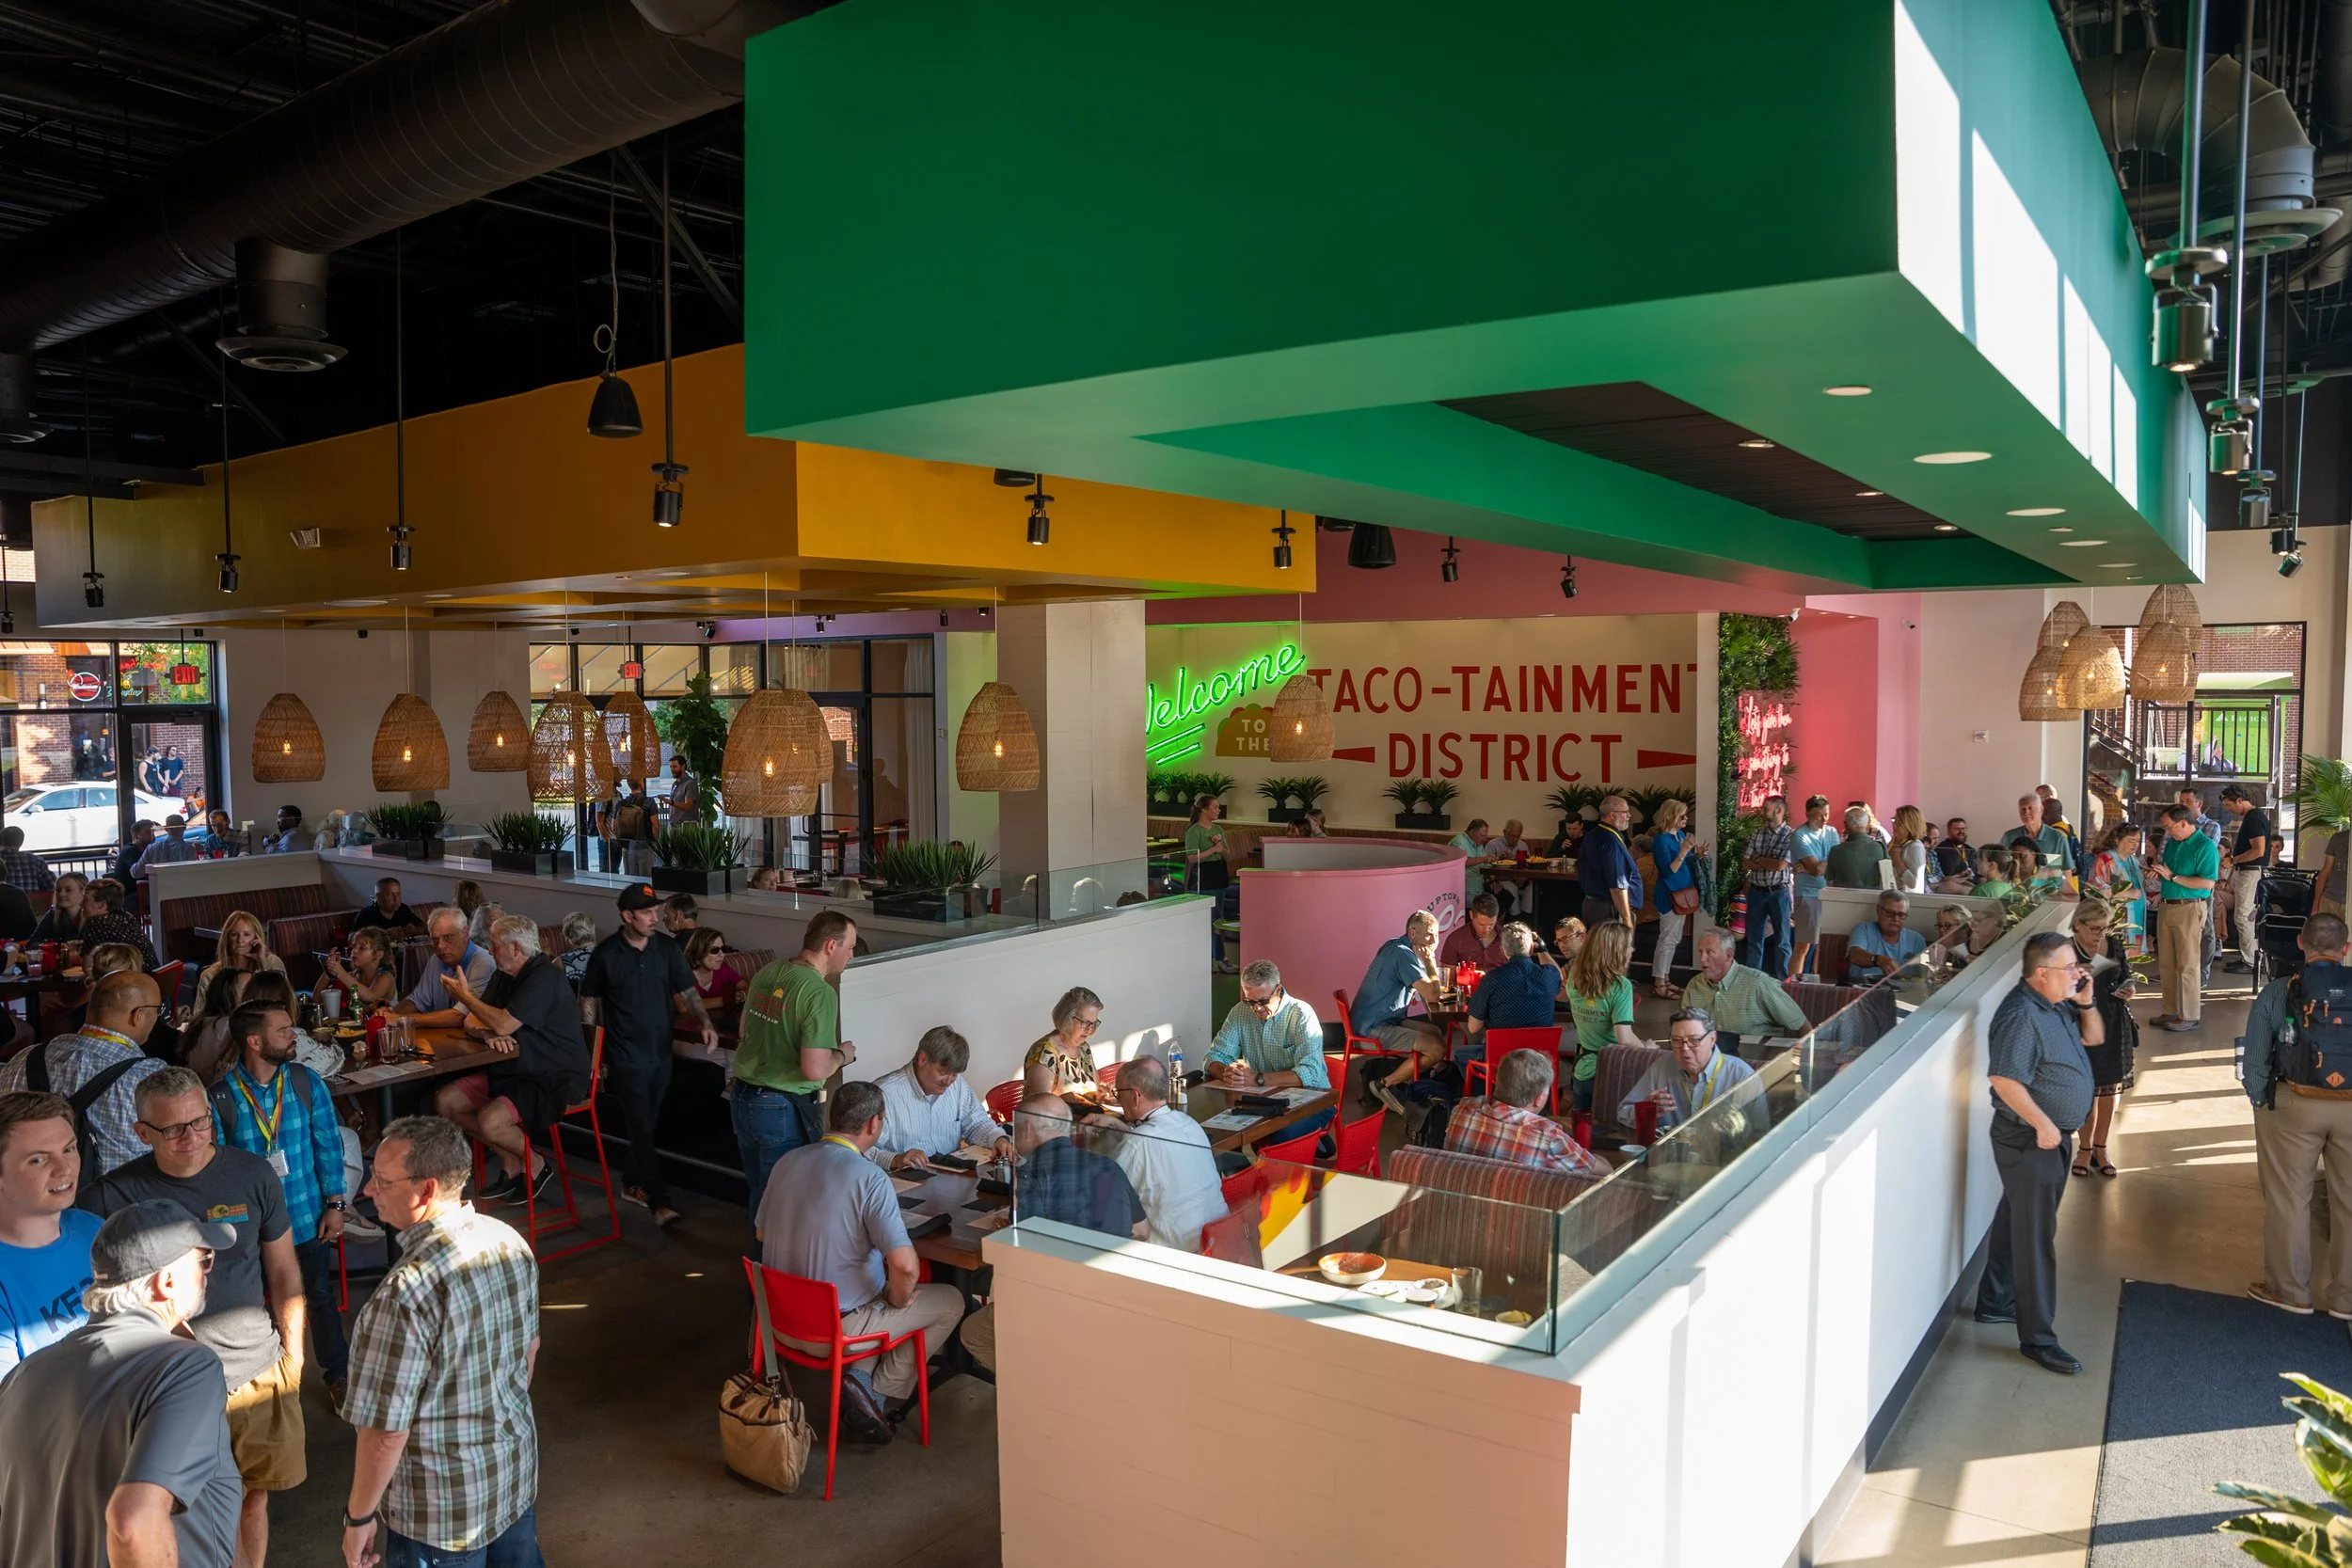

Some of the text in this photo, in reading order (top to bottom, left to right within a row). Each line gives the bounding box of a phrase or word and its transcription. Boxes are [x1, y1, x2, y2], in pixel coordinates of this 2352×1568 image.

[174, 666, 197, 684] EXIT
[1306, 663, 1698, 714] TACO-TAINMEN
[1241, 719, 1266, 734] TO
[1236, 736, 1271, 752] THE
[1389, 732, 1623, 784] DISTRICT
